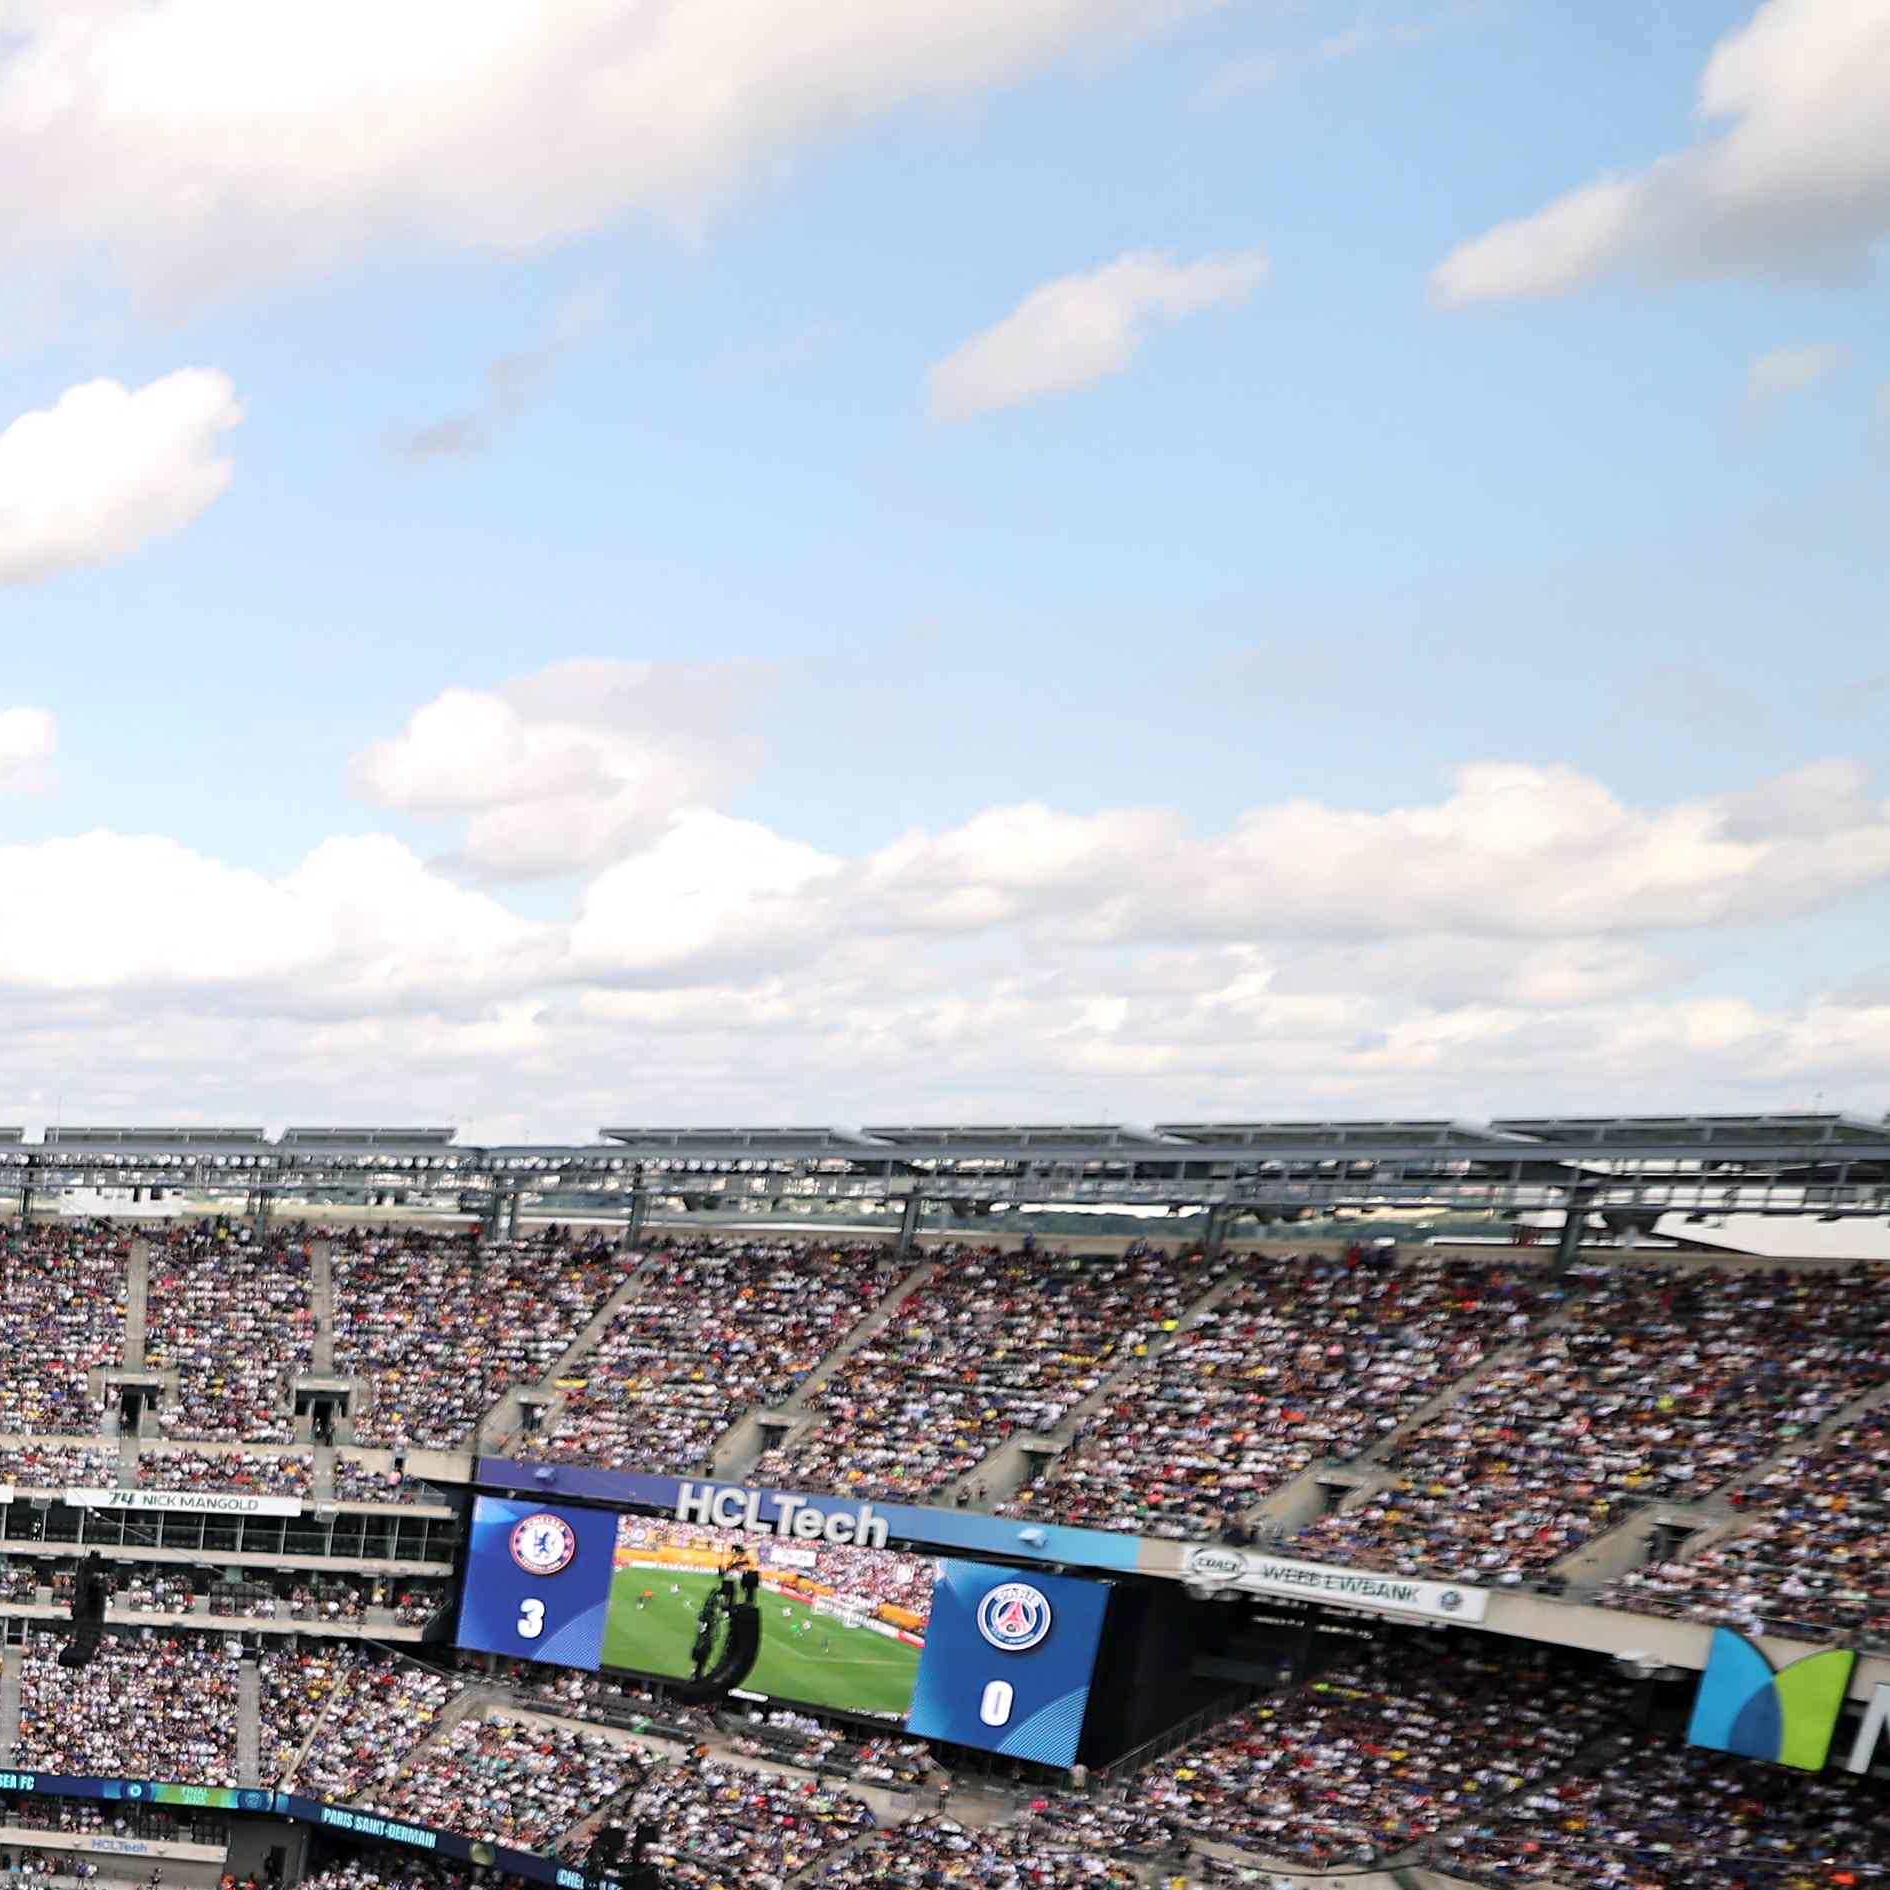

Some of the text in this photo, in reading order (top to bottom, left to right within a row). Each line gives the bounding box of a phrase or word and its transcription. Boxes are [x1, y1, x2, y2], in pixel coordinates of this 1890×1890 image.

[108, 1492, 258, 1512] 74 NICK MANGOLD
[677, 1482, 889, 1547] HCLTech
[519, 1598, 545, 1639] 3
[980, 1679, 1013, 1727] 0
[19, 1775, 35, 1791] FC
[92, 1837, 148, 1854] HCLTech
[322, 1807, 436, 1849] PARIS SAINT-GERMAIN
